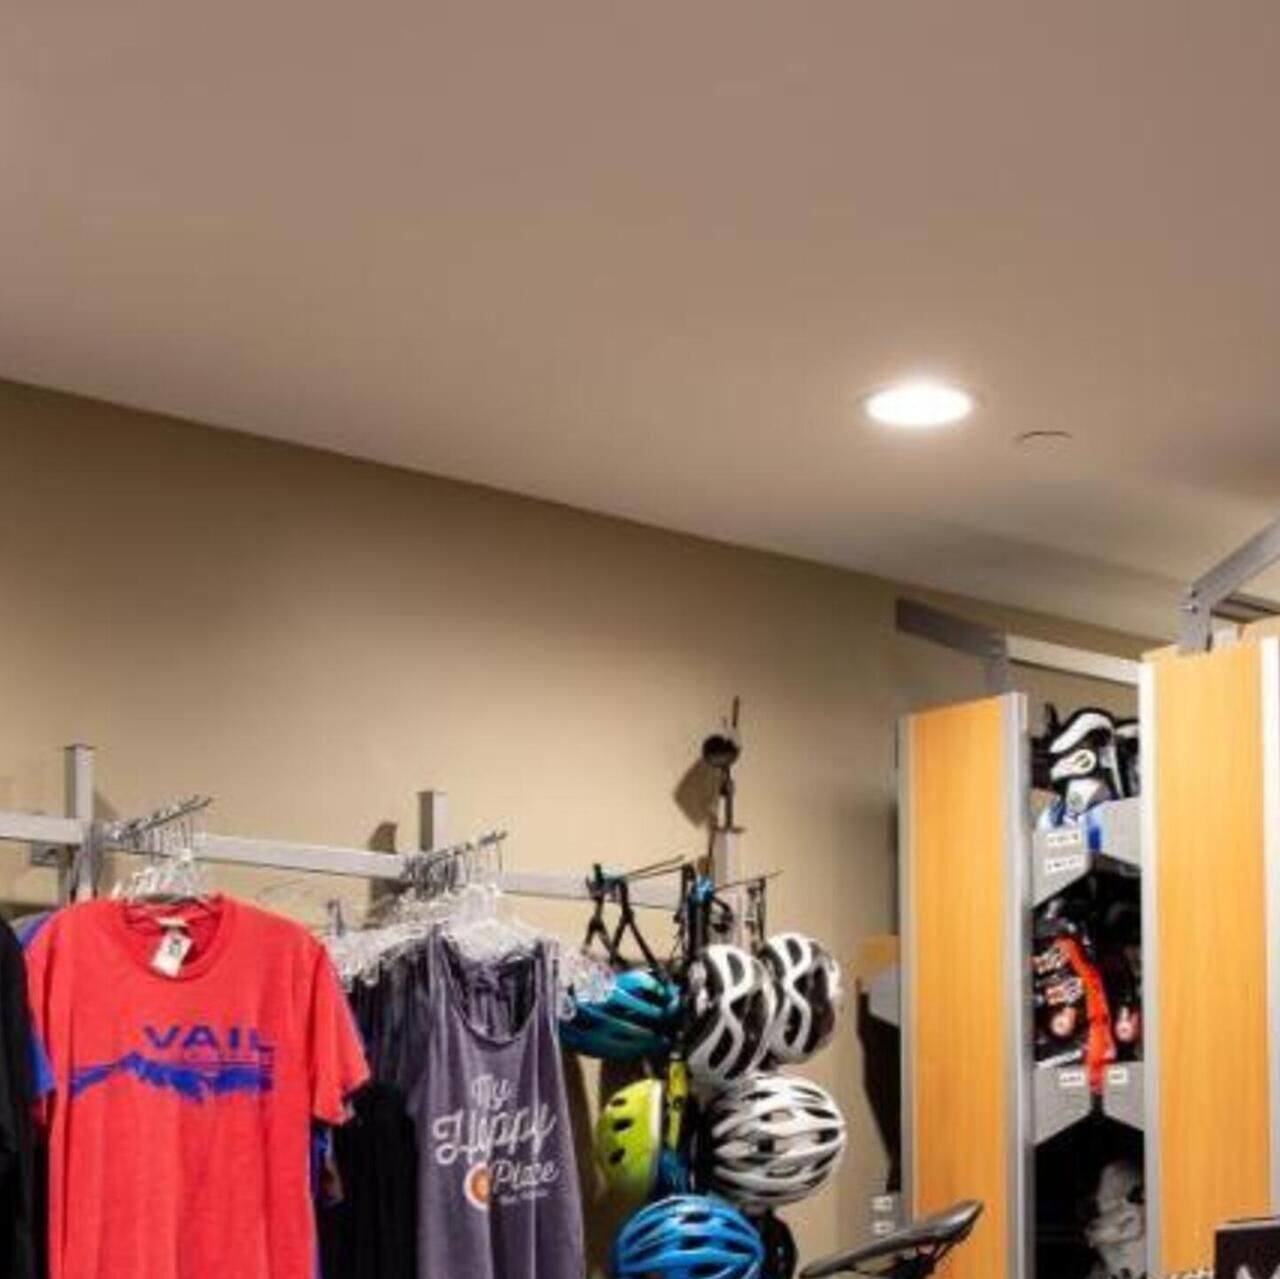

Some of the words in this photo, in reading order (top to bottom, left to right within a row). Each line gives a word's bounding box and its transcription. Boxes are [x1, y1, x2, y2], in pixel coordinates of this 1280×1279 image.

[143, 1023, 275, 1053] VAIL
[432, 1102, 558, 1166] Happy
[488, 1159, 560, 1194] Place
